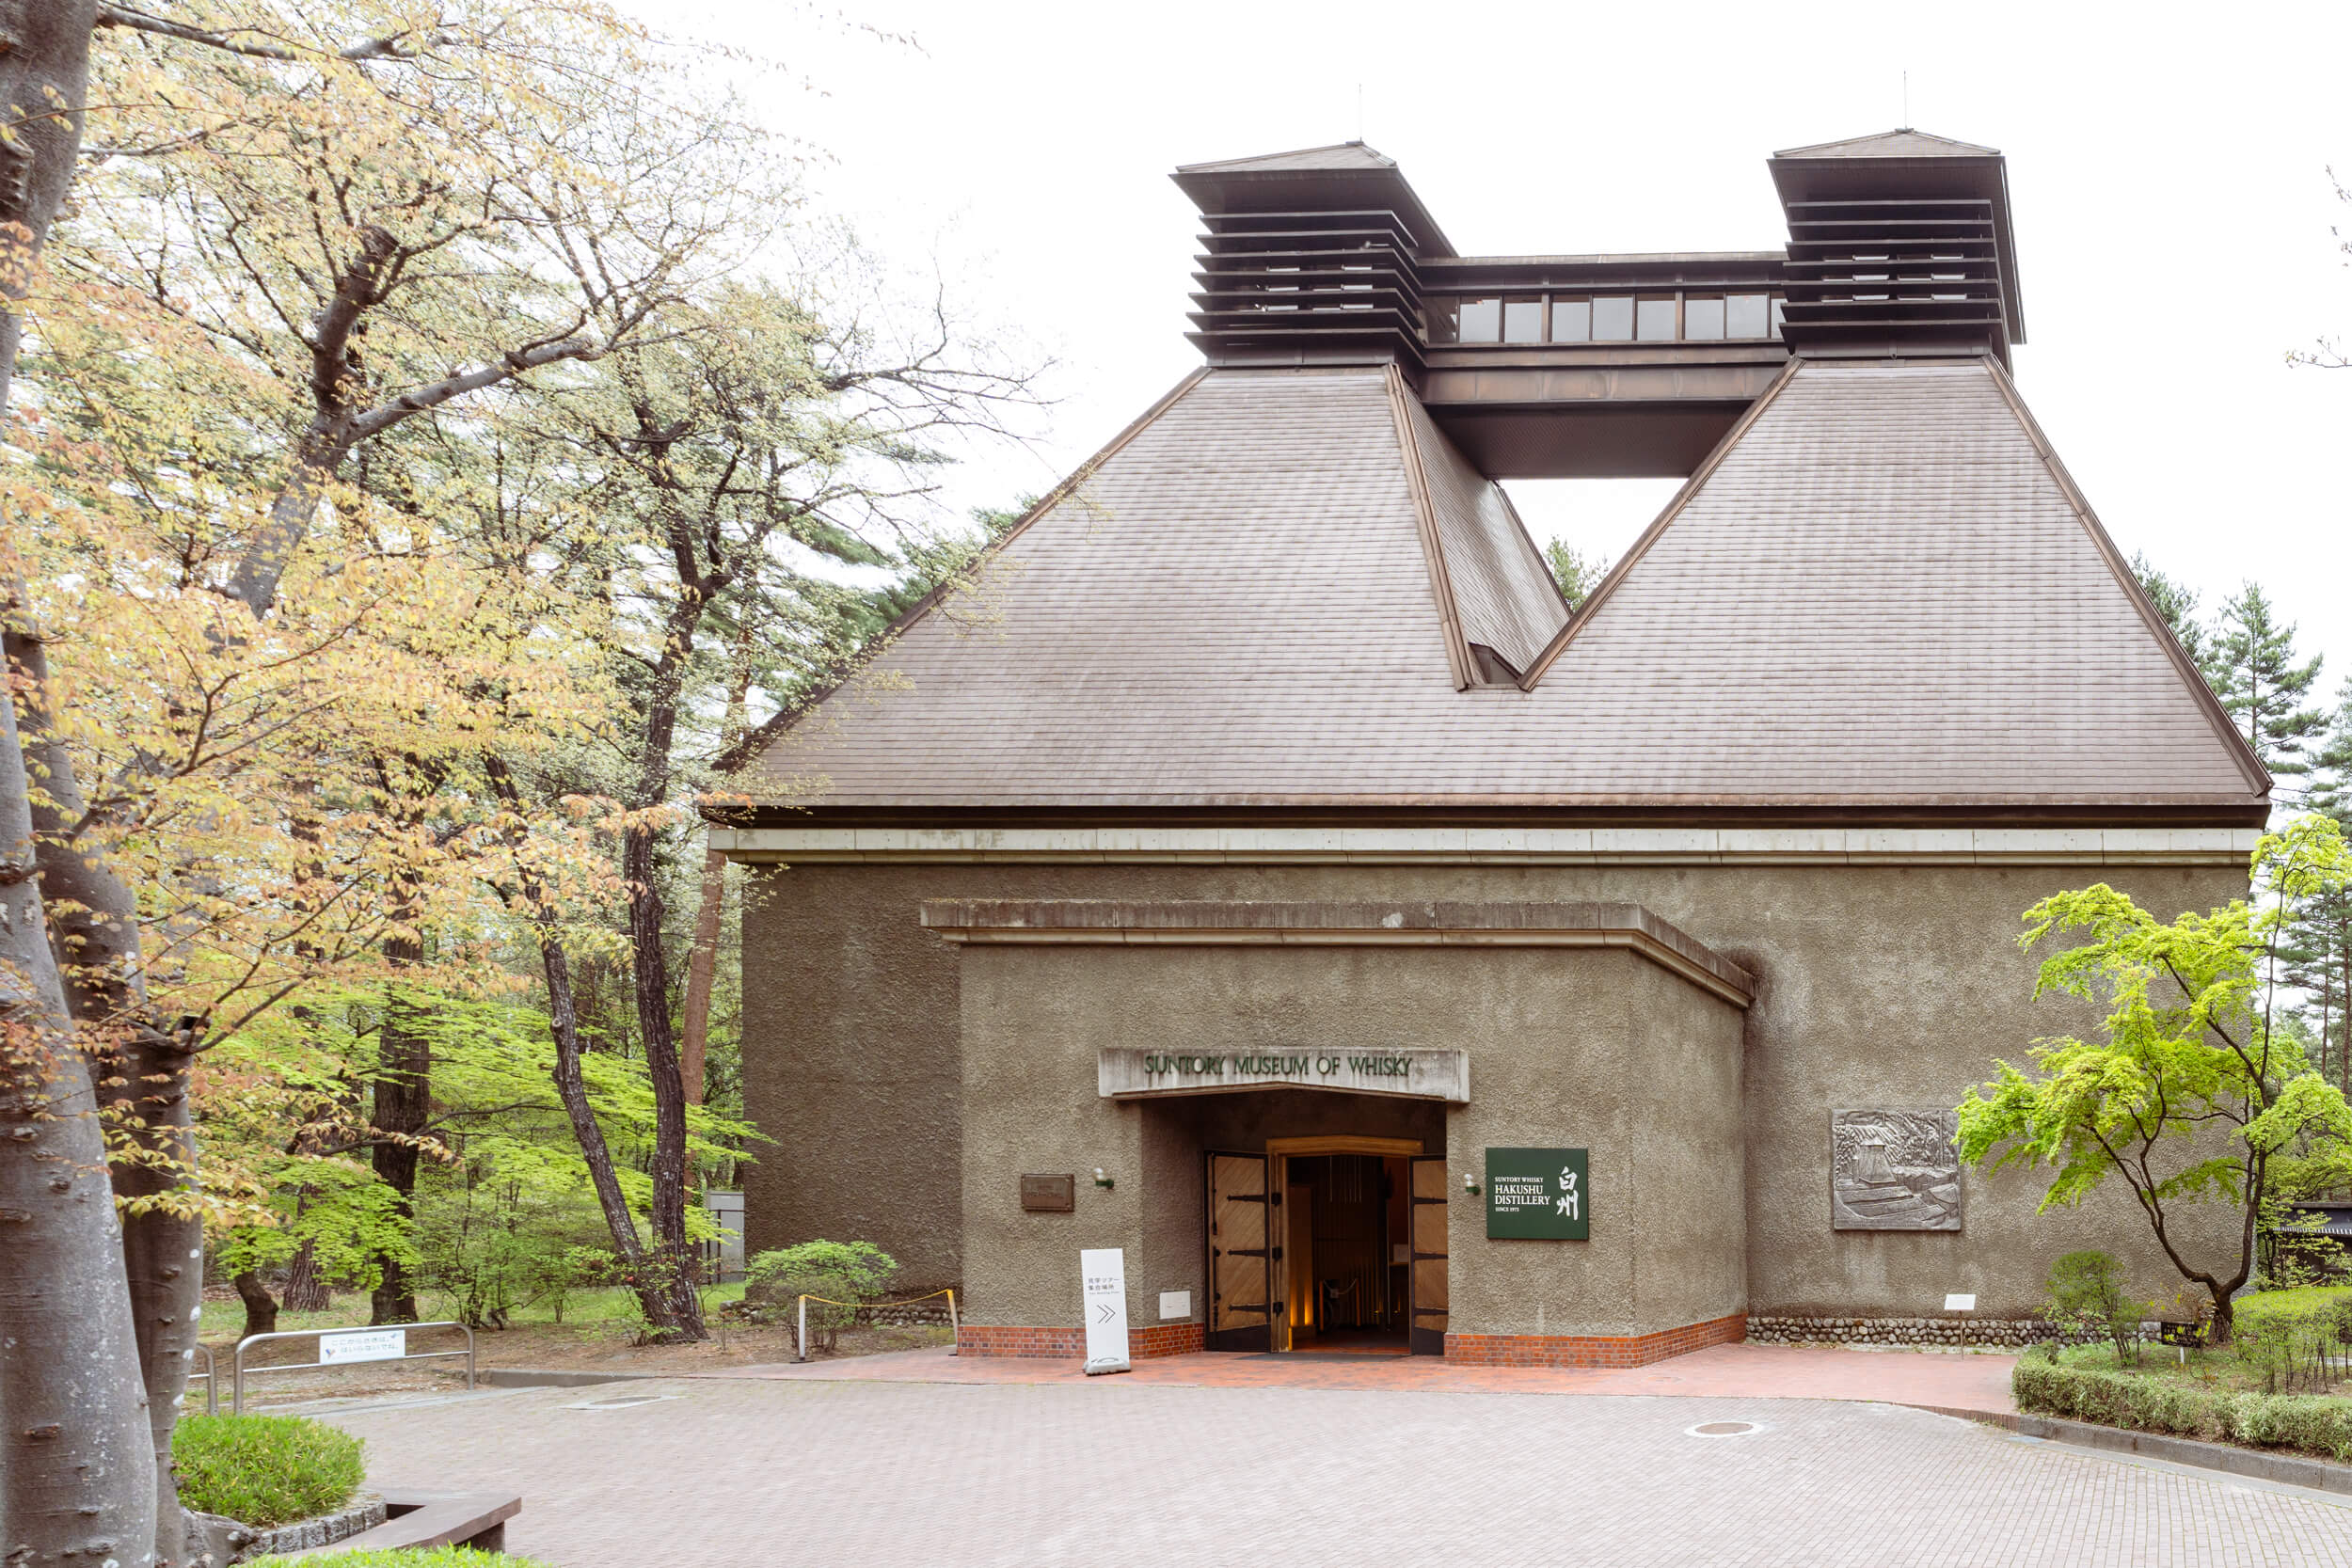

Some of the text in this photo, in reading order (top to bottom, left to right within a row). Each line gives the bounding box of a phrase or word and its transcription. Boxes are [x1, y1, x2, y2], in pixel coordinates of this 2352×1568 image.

[1145, 1055, 1412, 1076] SUNTORY MUSEUM OF WHISKY
[1495, 1184, 1544, 1195] HAKUSHU
[1556, 1165, 1579, 1221] 白州
[1494, 1195, 1551, 1205] DISTILLERY
